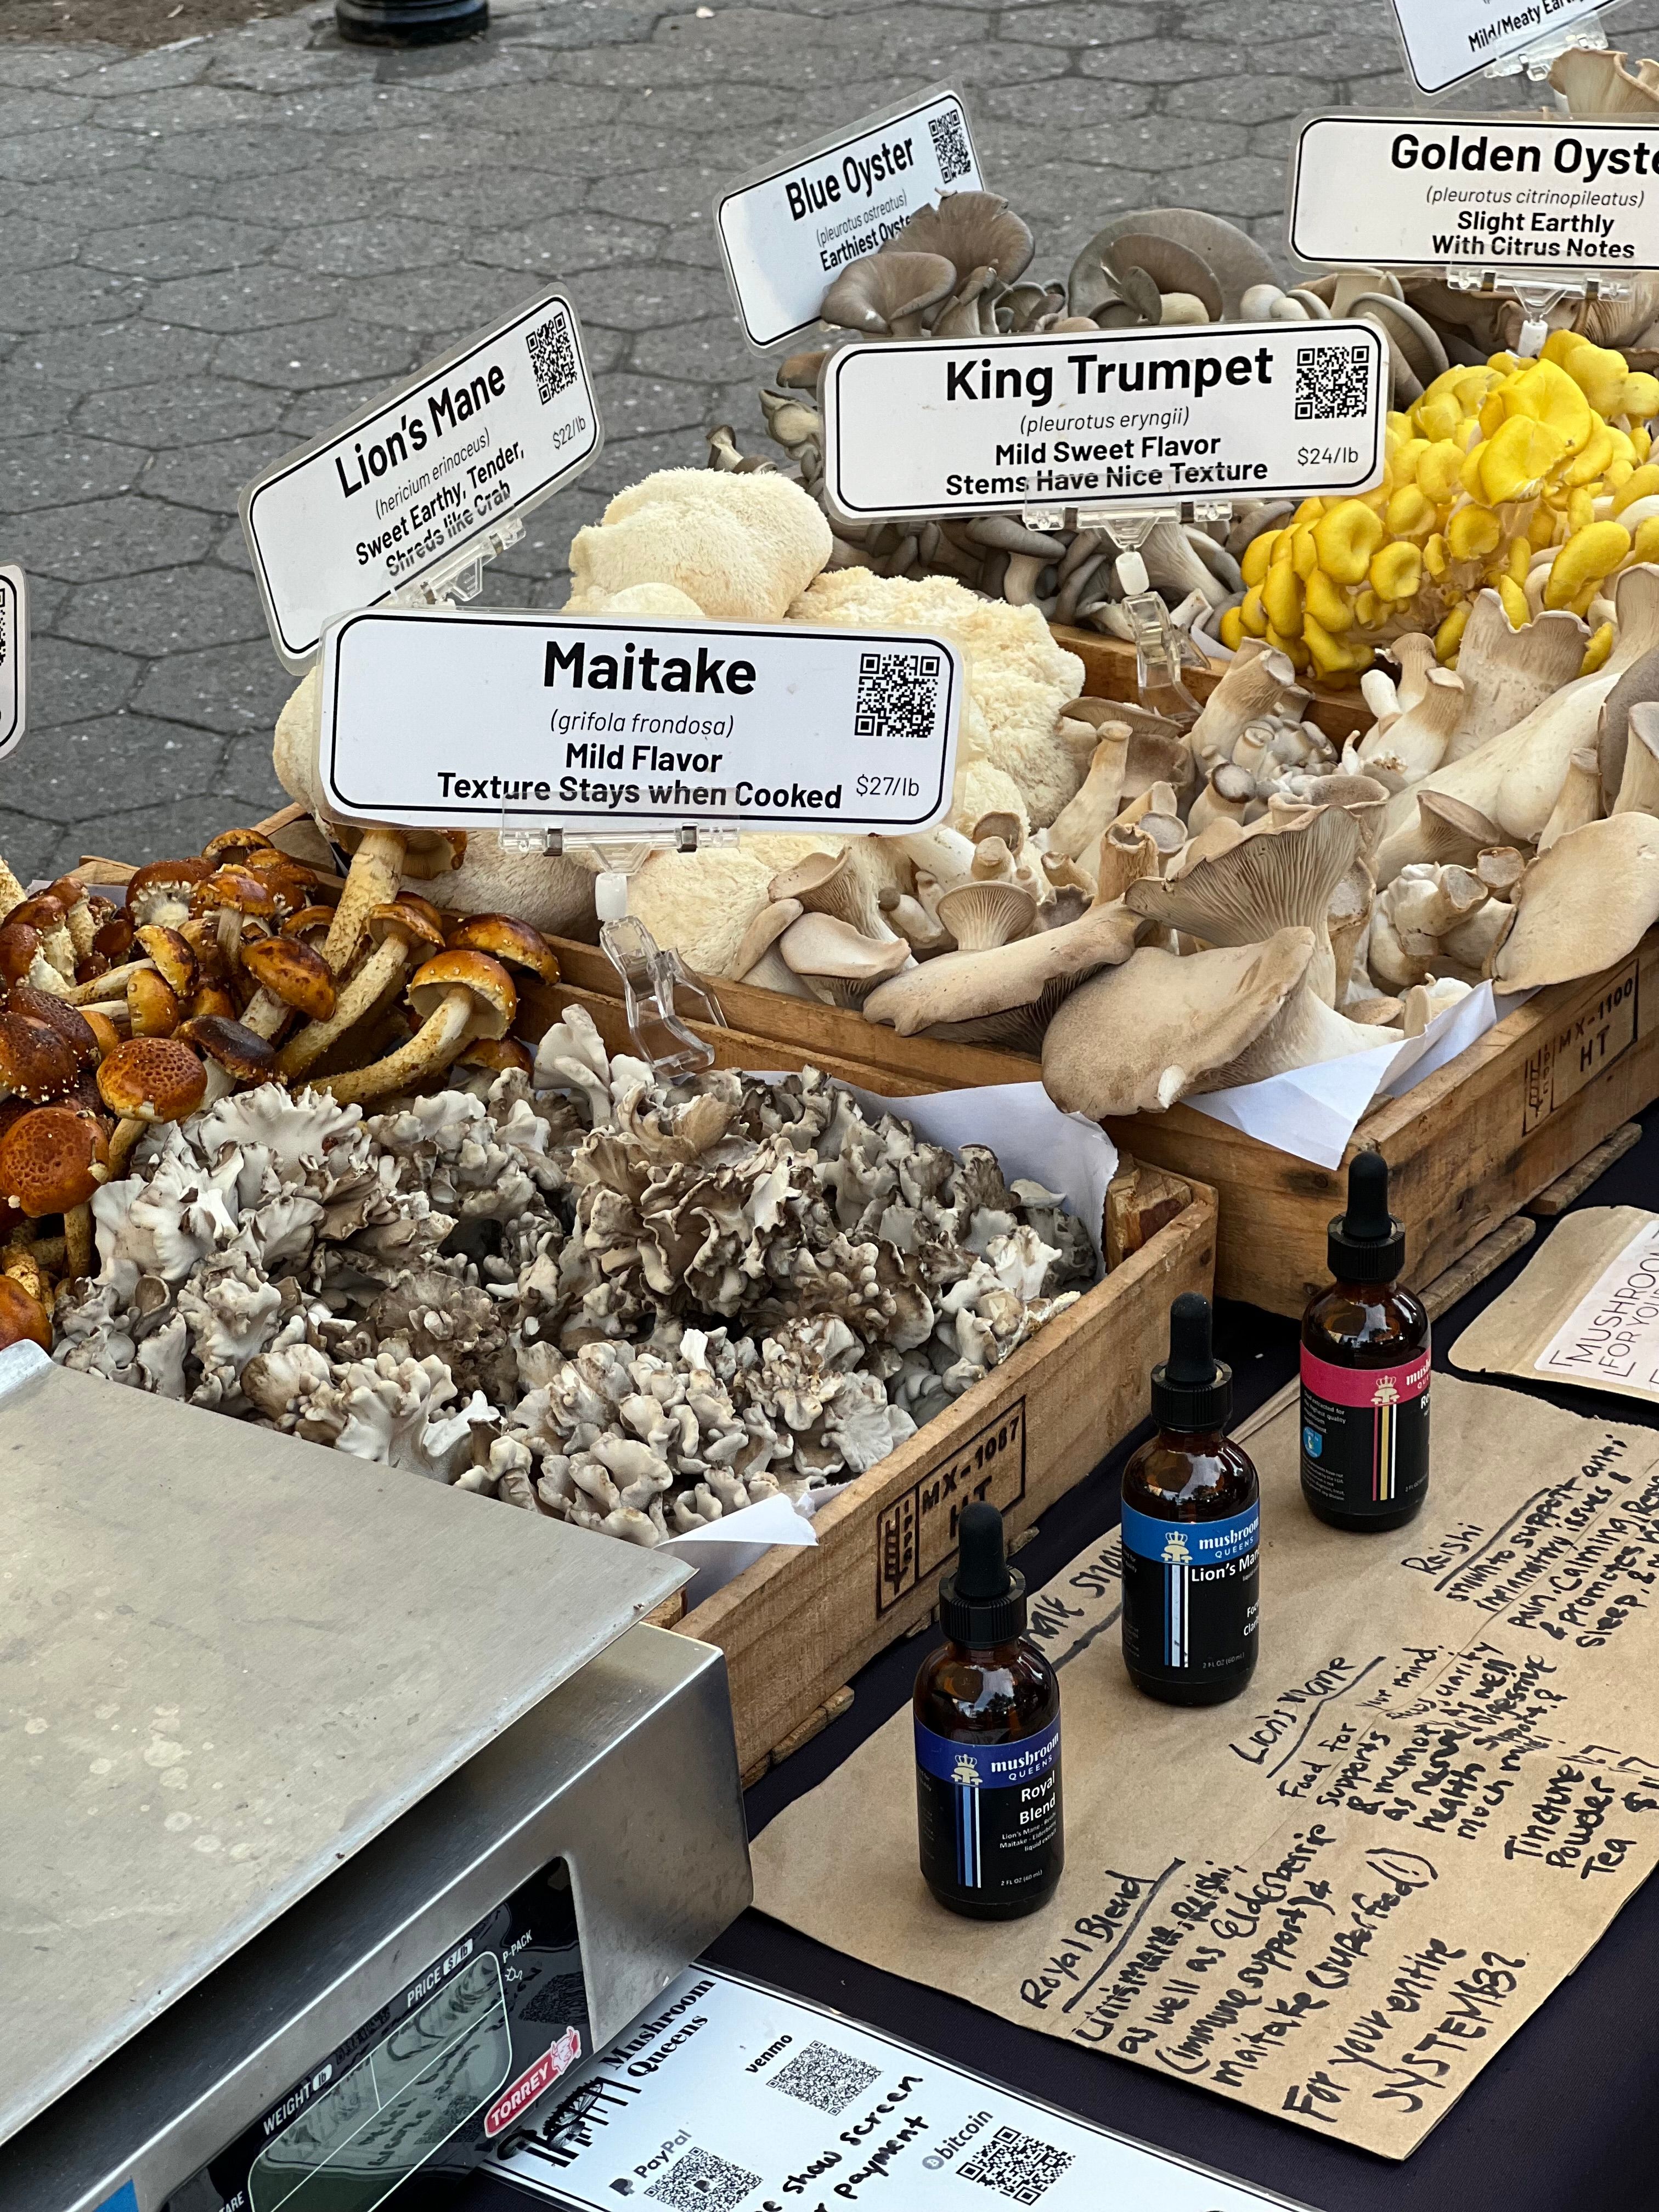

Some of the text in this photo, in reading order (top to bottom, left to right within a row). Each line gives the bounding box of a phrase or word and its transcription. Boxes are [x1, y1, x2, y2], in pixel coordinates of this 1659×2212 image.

[1468, 5, 1541, 52] Mild/Meaty
[1392, 134, 1541, 172] Golden
[786, 138, 914, 221] Blue Oyster
[1426, 187, 1645, 208] (pleurotus citrinopileatus)
[817, 189, 908, 247] (pleurotus ostreatus)
[1458, 212, 1615, 237] Slight Earthly
[820, 228, 879, 271] Earthiest
[1432, 236, 1634, 258] With Citrus Notes
[946, 347, 1273, 407] King Trumpet
[335, 365, 505, 498] Lion's Mane
[553, 415, 587, 450] $22/lb
[1020, 407, 1190, 437] (pleurotus eryngii)
[996, 435, 1221, 466] Mild Sweet Flavor
[1297, 446, 1360, 467] $24/lb
[376, 427, 490, 520] (hericium erinaceus)
[945, 459, 1269, 496] Stems Have Nice Texture
[356, 442, 524, 566] Sweet Earthy, Tender,
[385, 479, 511, 577] Shreds like Crab
[544, 641, 757, 696] Maitake
[550, 709, 735, 738] (grifola frondosa)
[566, 742, 724, 774] Mild Flavor
[437, 771, 843, 810] Texture Stays when Cooked
[856, 775, 920, 799] $27/lb
[1581, 1025, 1610, 1073] HT
[1565, 1251, 1659, 1364] MUSHROO
[1598, 1329, 1642, 1369] FOR
[923, 1416, 1019, 1515] MX-1087
[1582, 1434, 1628, 1478] anti
[1215, 1536, 1254, 1559] QUEENS
[1401, 1522, 1484, 1575] Reishi
[1191, 1563, 1236, 1582] Lion's
[991, 1732, 1059, 1773] mushroom
[1008, 1754, 1053, 1781] QUEENS
[1021, 1770, 1056, 1803] Royal
[1277, 1760, 1332, 1798] Food
[1019, 1792, 1057, 1825] Blend
[1457, 1780, 1514, 1840] much
[1504, 1763, 1585, 1860] Tincture
[1545, 1776, 1616, 1869] Powder
[1581, 1838, 1638, 1880] Tea
[503, 1929, 533, 1963] P-PACK
[1020, 1870, 1155, 2009] Royal Blend
[407, 1967, 441, 2008] PRICE
[1145, 1978, 1200, 2024] well
[1186, 1945, 1227, 1972] as
[600, 1979, 716, 2071] Mushroom
[627, 2015, 709, 2078] Queens
[745, 2034, 793, 2074] venmo
[1282, 2071, 1350, 2123] For
[1327, 2010, 1397, 2074] your
[263, 2082, 314, 2136] WEIGHT
[490, 2061, 550, 2127] TORREY
[840, 2075, 924, 2146] screen
[634, 2129, 692, 2179] PayPal
[833, 2115, 929, 2200] payment
[934, 2109, 994, 2161] bitcoin
